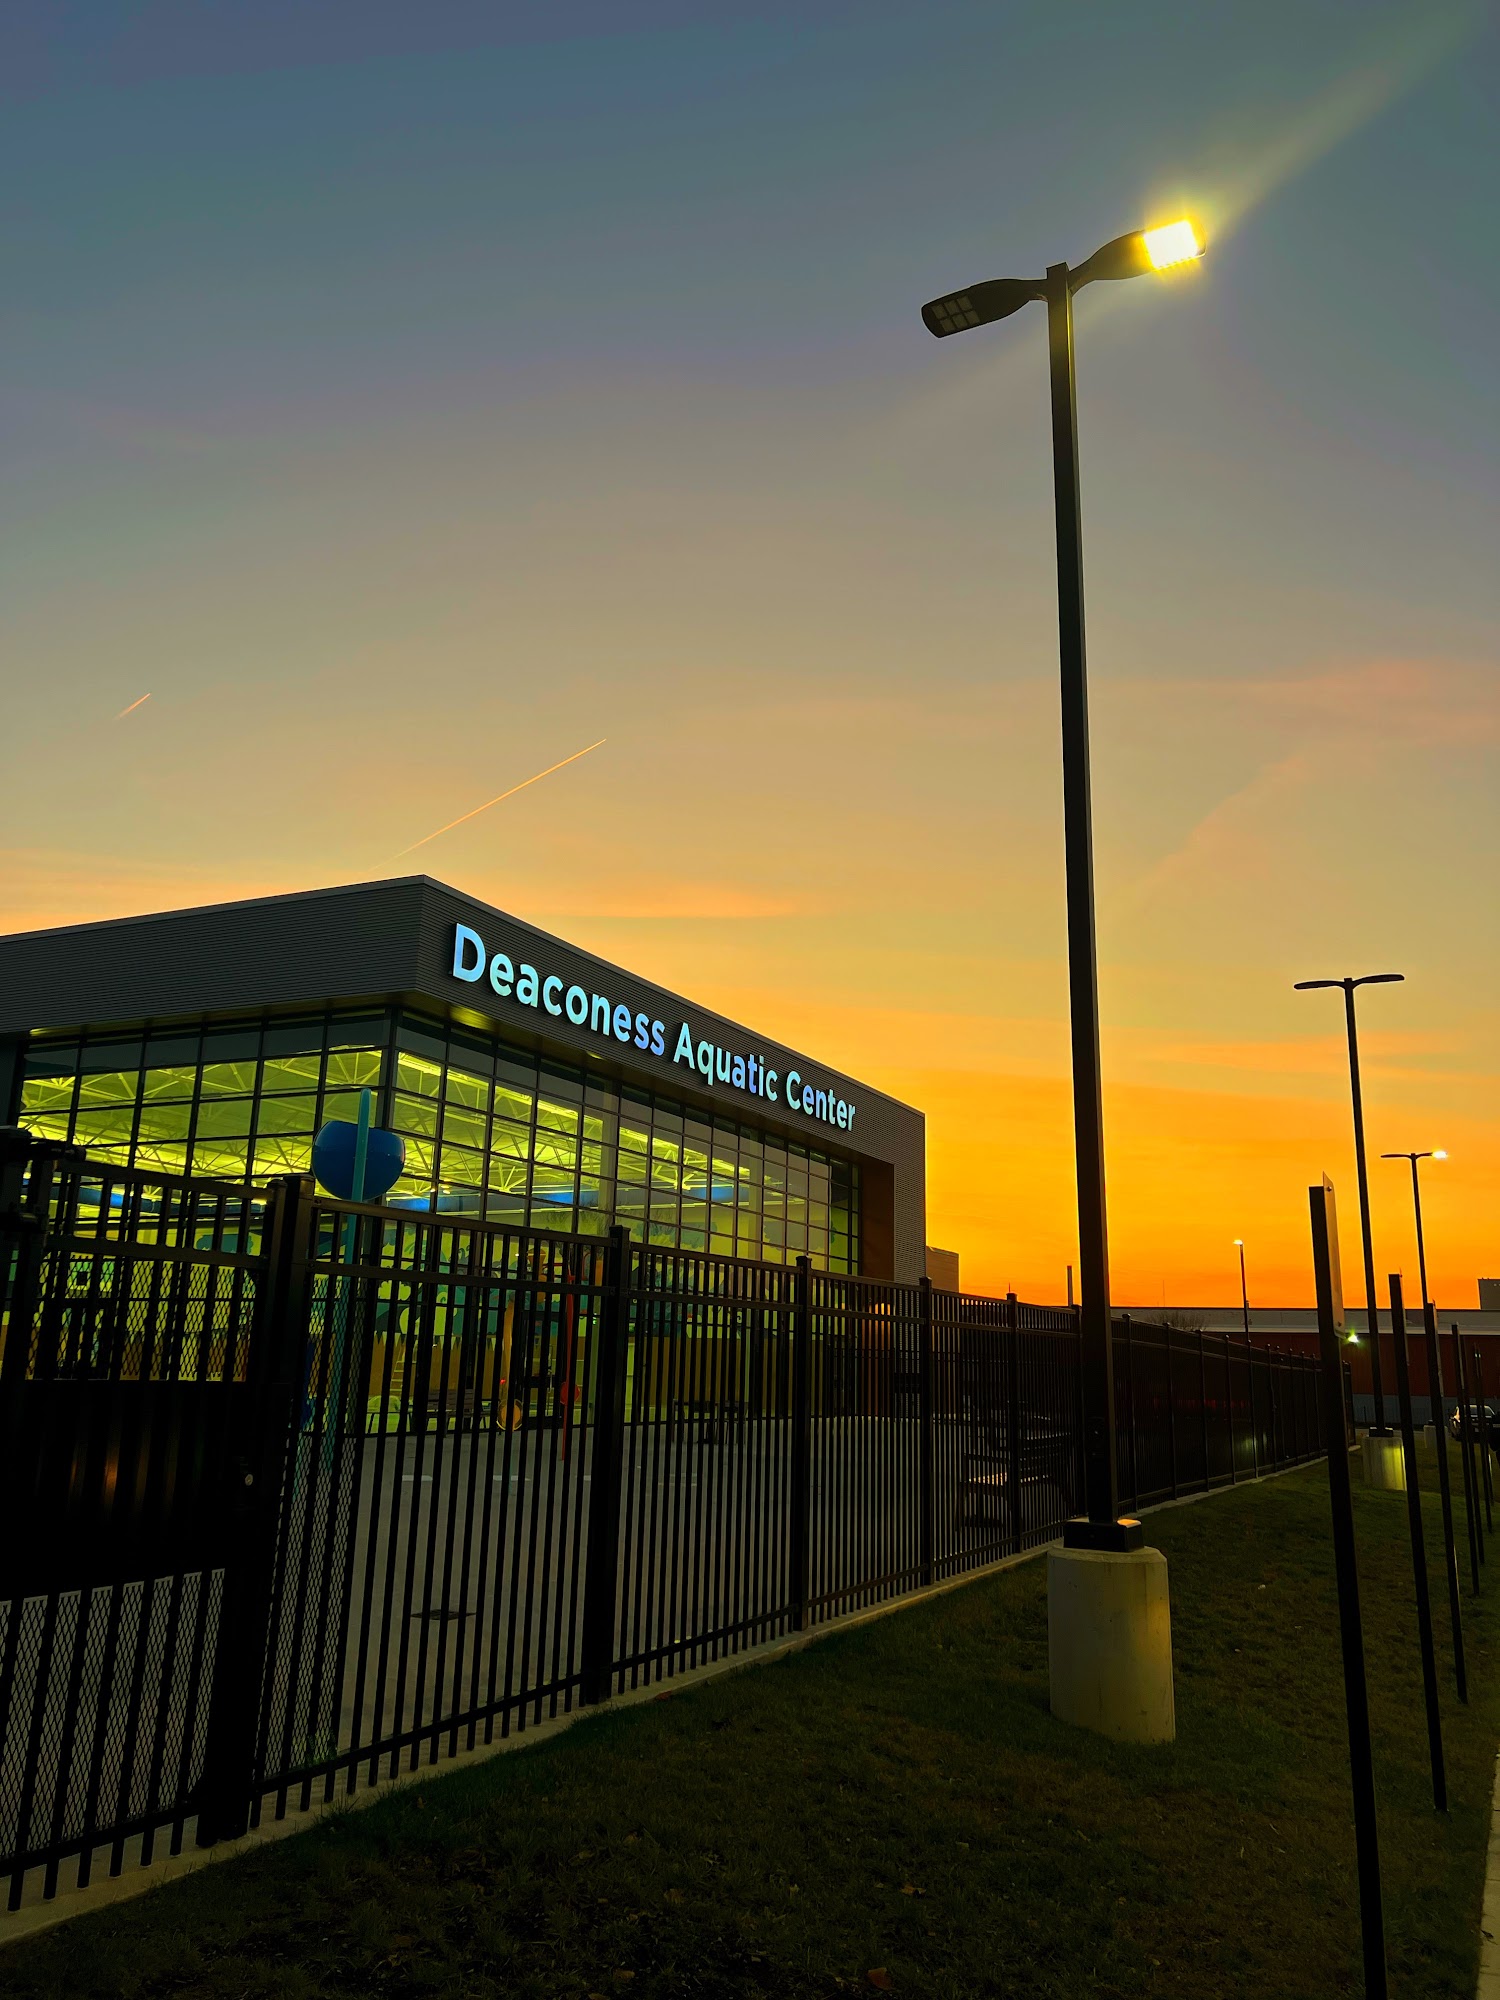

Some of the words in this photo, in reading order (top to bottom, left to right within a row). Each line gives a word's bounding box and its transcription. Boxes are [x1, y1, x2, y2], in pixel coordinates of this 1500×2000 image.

[452, 922, 666, 1056] Deaconess
[673, 1022, 778, 1102] Aquatic
[786, 1071, 857, 1131] Center
